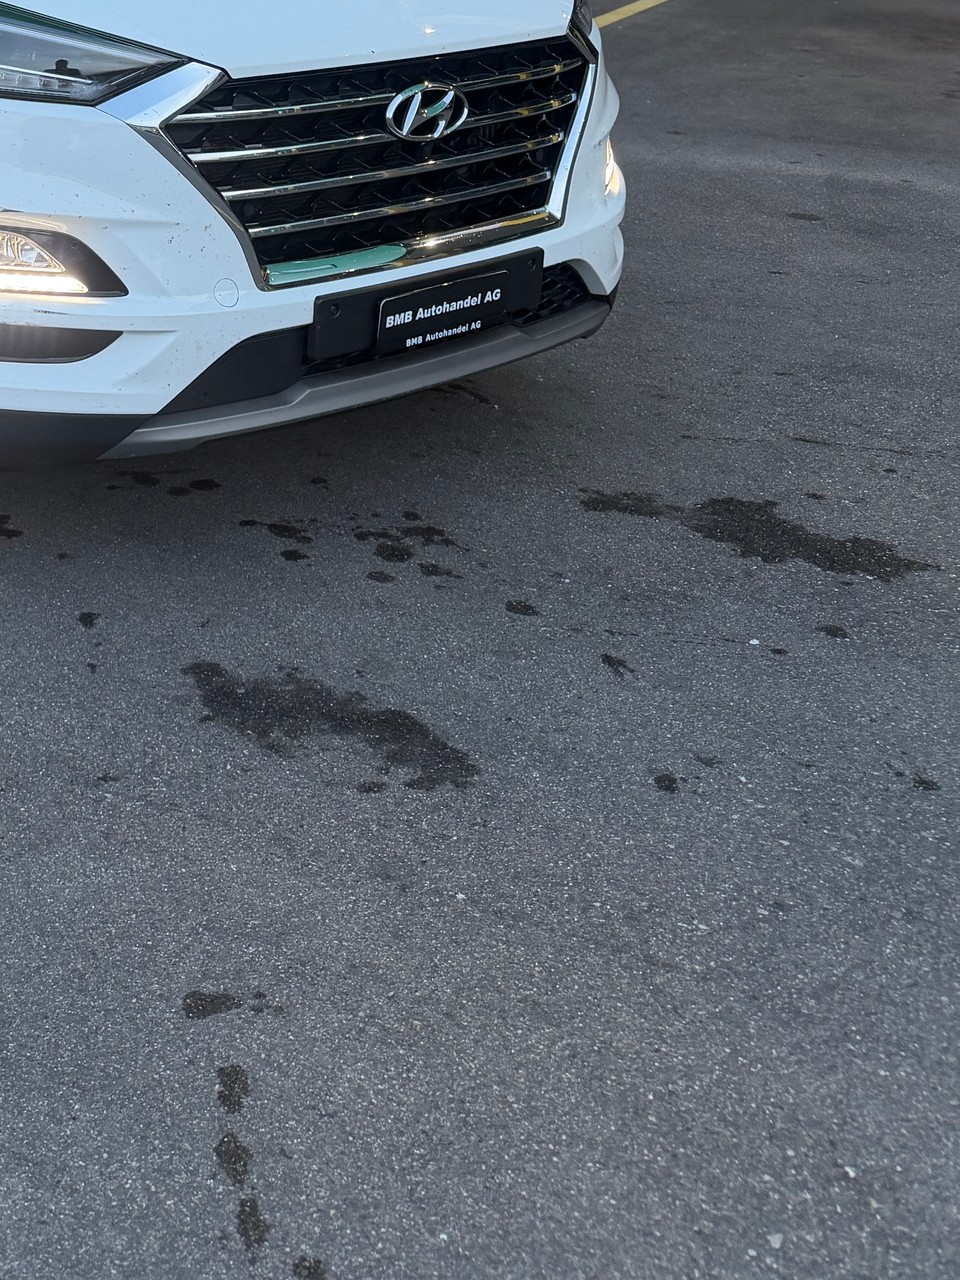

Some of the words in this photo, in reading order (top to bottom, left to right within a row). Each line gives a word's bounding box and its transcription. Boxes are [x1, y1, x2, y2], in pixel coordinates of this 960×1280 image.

[385, 310, 413, 328] BMB
[415, 293, 481, 320] Autohandel
[483, 288, 501, 302] AG
[406, 335, 423, 347] BMB
[425, 323, 469, 342] Autohandel
[470, 320, 481, 329] AG
